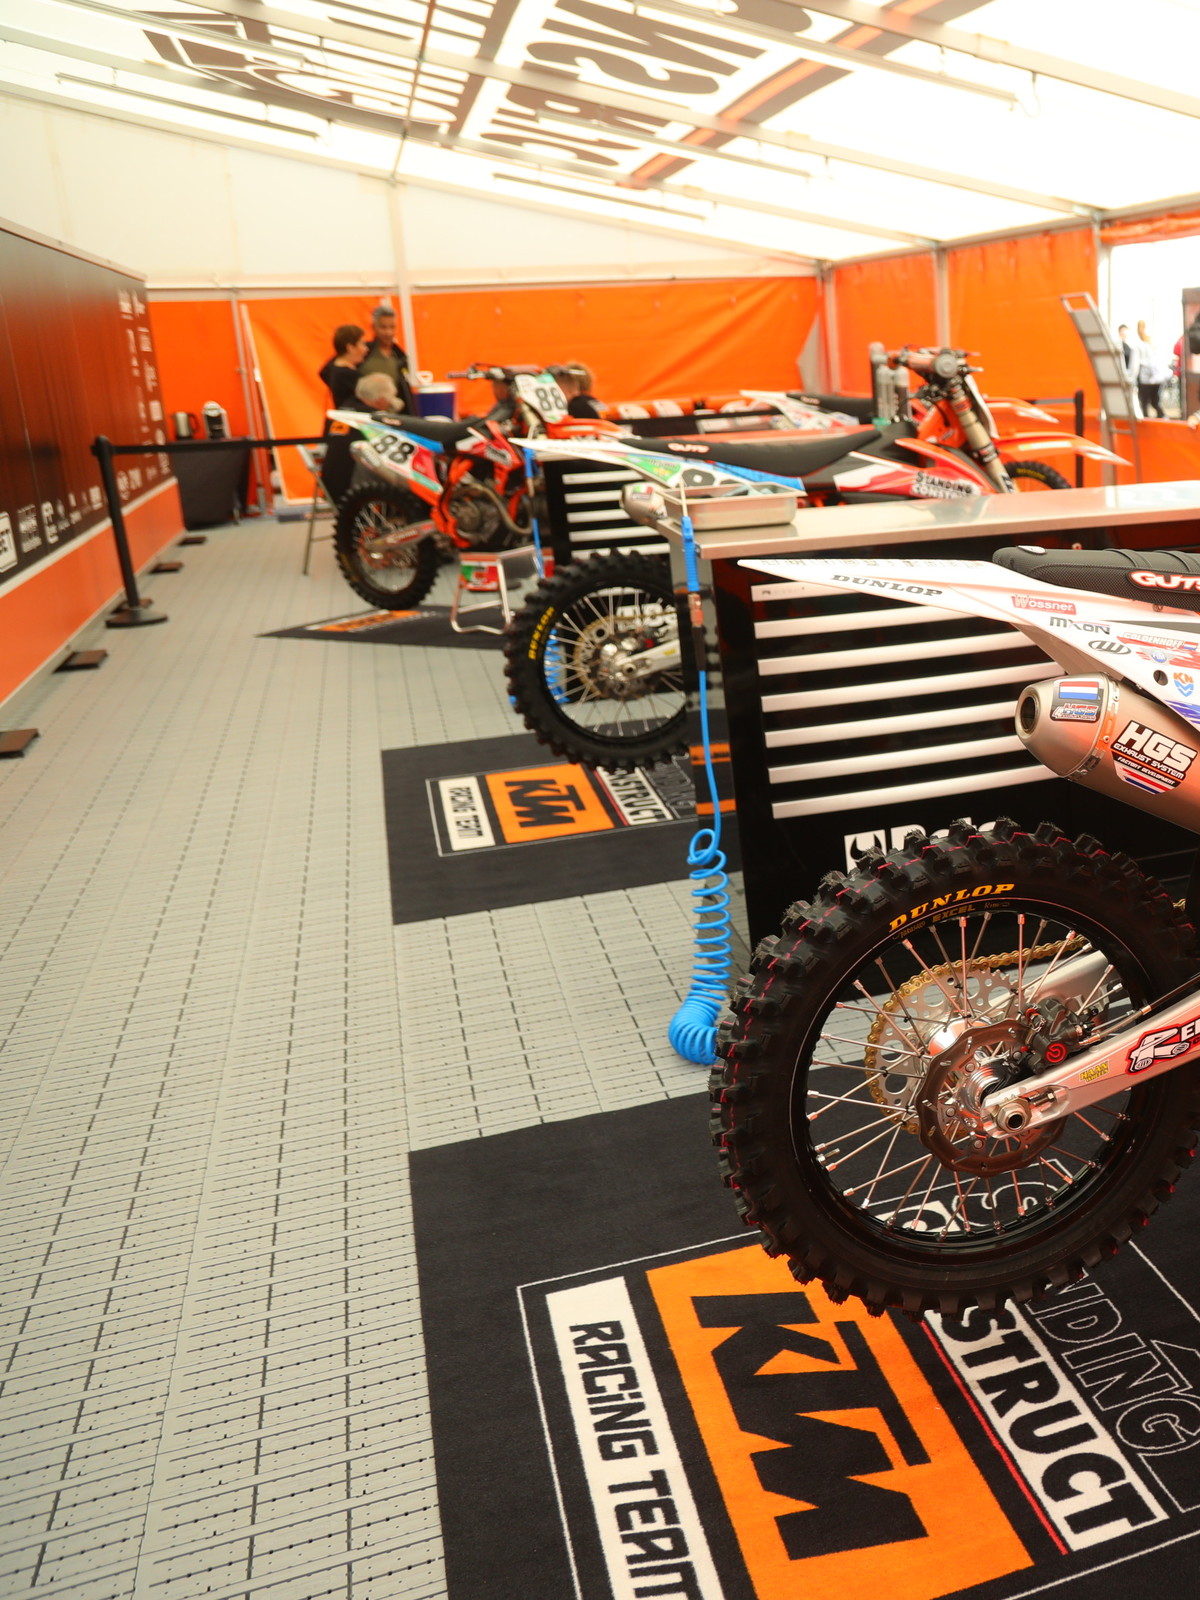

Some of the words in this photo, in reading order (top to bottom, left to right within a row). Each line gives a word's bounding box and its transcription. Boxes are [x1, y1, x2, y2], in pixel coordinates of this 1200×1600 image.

[534, 385, 567, 413] 88
[371, 433, 416, 465] 88
[832, 574, 943, 597] DUNLOP
[1123, 631, 1185, 649] GOLDENHOFF
[1113, 742, 1151, 766] EXHAUST
[1150, 759, 1186, 780] SYSTEM
[1116, 720, 1198, 773] HGS
[1117, 756, 1142, 771] FACTORY
[1140, 765, 1176, 786] DEVELOPMENT
[504, 778, 587, 829] KTM
[888, 883, 1015, 933] DUNLOP
[932, 904, 976, 923] EXCEL
[1080, 1061, 1109, 1080] HAAN
[568, 1319, 660, 1462] RACING
[690, 1291, 932, 1562] KTM
[608, 1468, 700, 1600] TEAM
